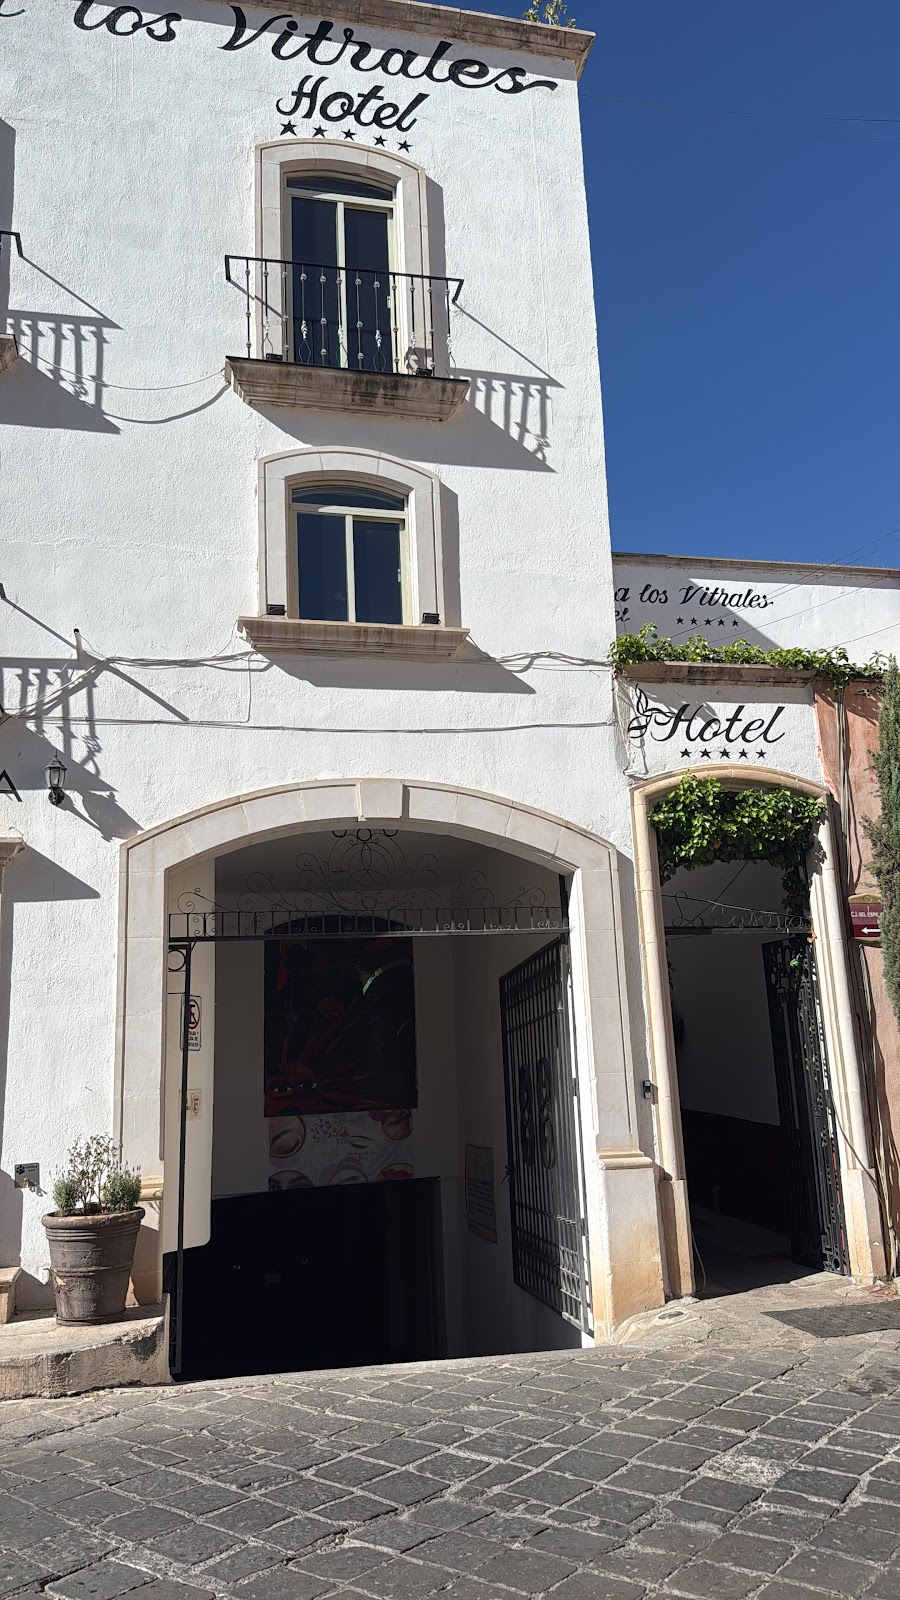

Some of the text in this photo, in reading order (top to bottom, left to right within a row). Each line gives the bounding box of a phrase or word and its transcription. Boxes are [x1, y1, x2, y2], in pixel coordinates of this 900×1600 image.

[73, 0, 559, 94] los Vitrales
[276, 74, 430, 132] Hotel
[639, 583, 669, 604] los
[678, 585, 774, 609] Vitrales
[650, 703, 786, 744] Hotel
